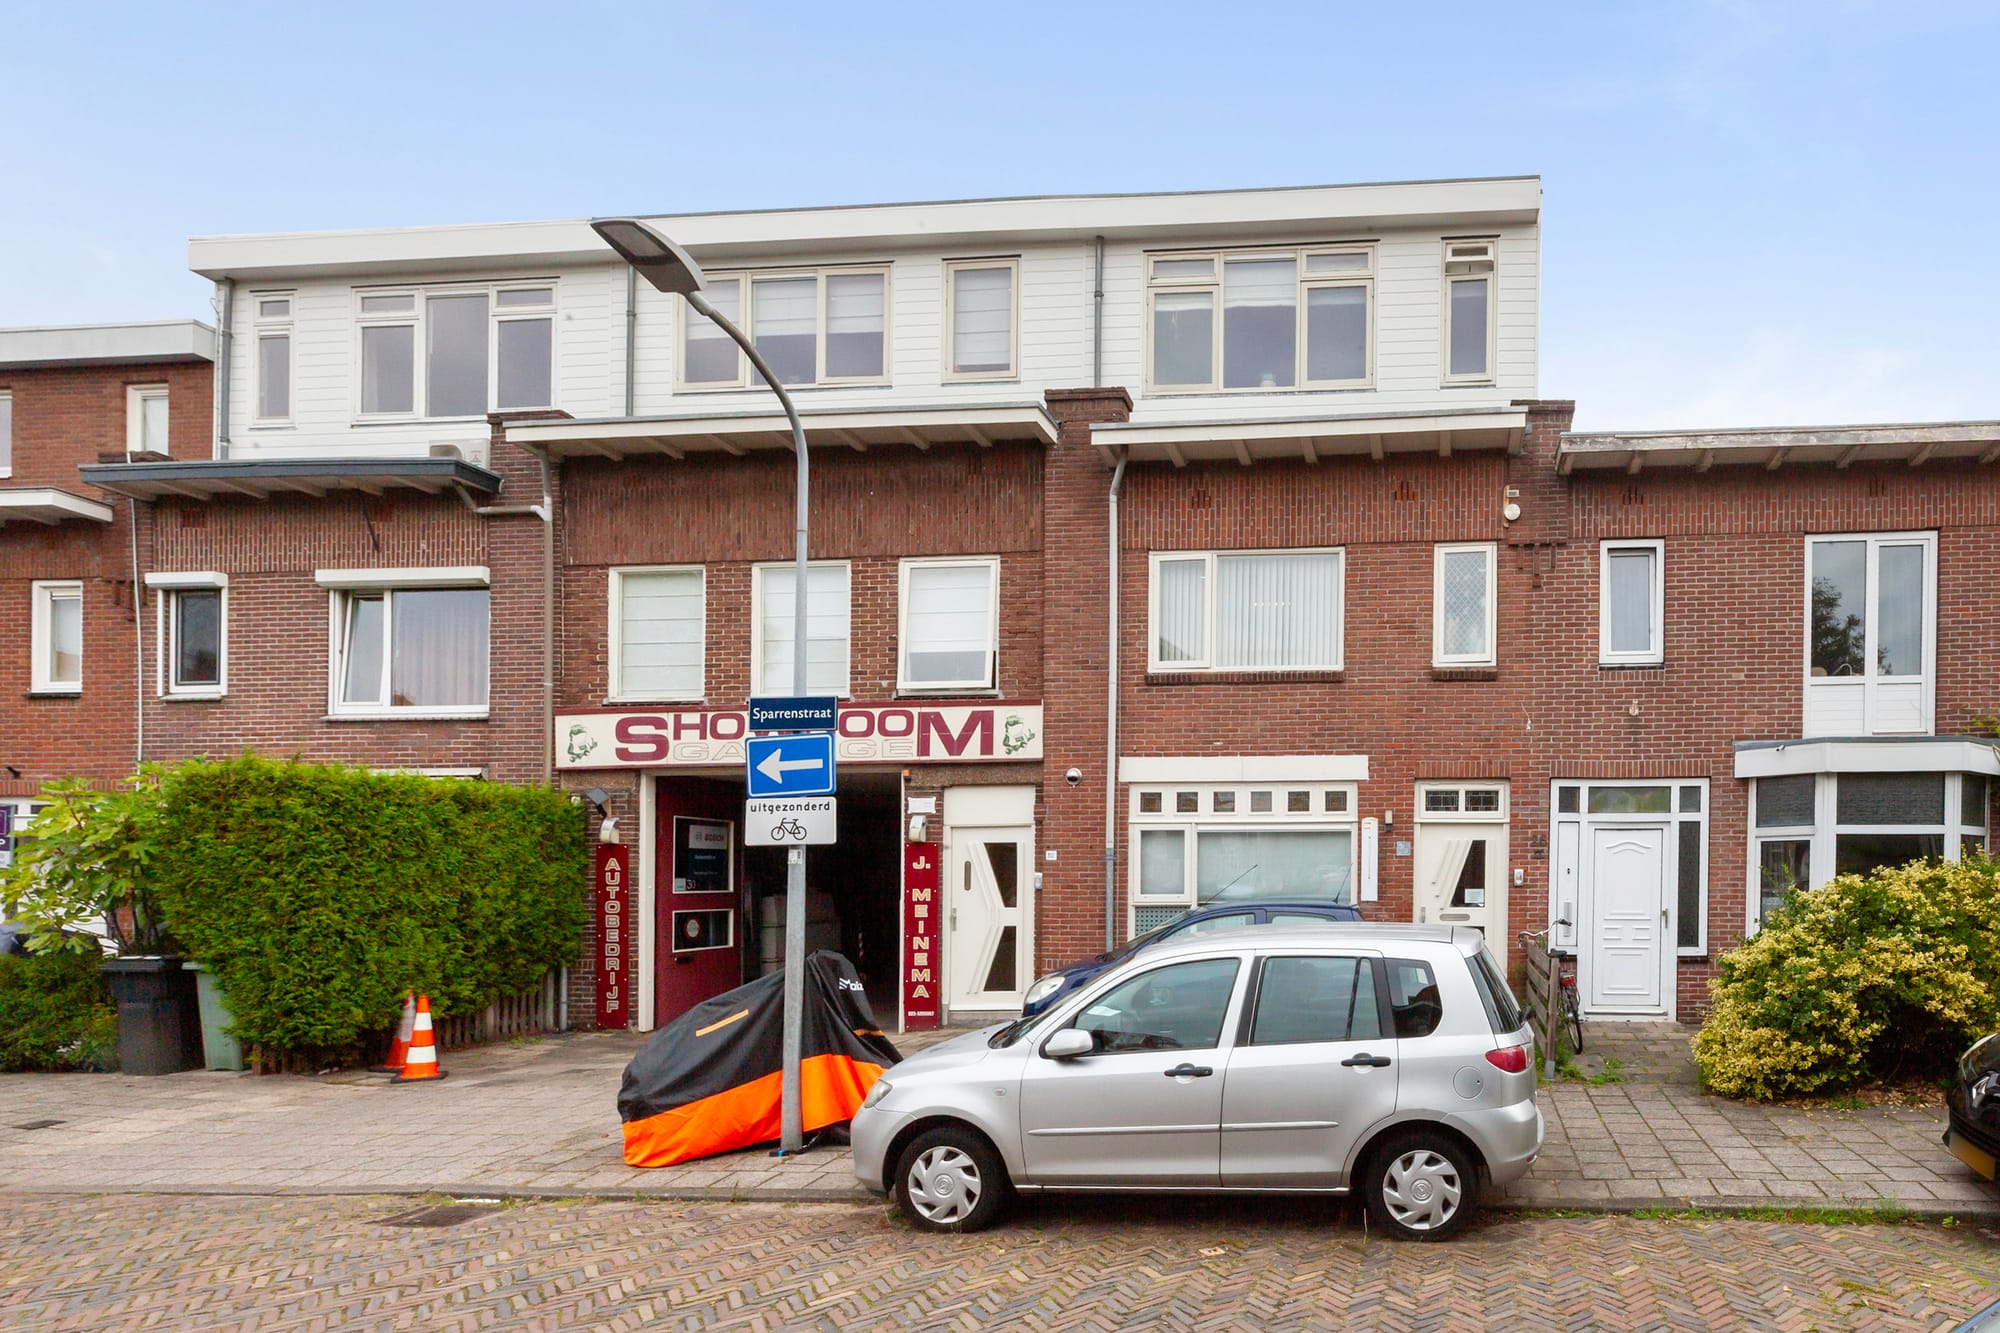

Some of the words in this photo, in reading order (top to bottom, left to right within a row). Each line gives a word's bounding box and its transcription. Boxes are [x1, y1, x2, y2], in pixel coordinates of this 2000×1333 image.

[752, 707, 832, 723] Sparrenstraat
[615, 709, 995, 763] SHOOOM
[672, 738, 914, 762] GAGE
[750, 801, 831, 815] uitgezonderd
[604, 857, 622, 1014] AUTOBEDRIJF
[912, 888, 932, 999] MEINEMA
